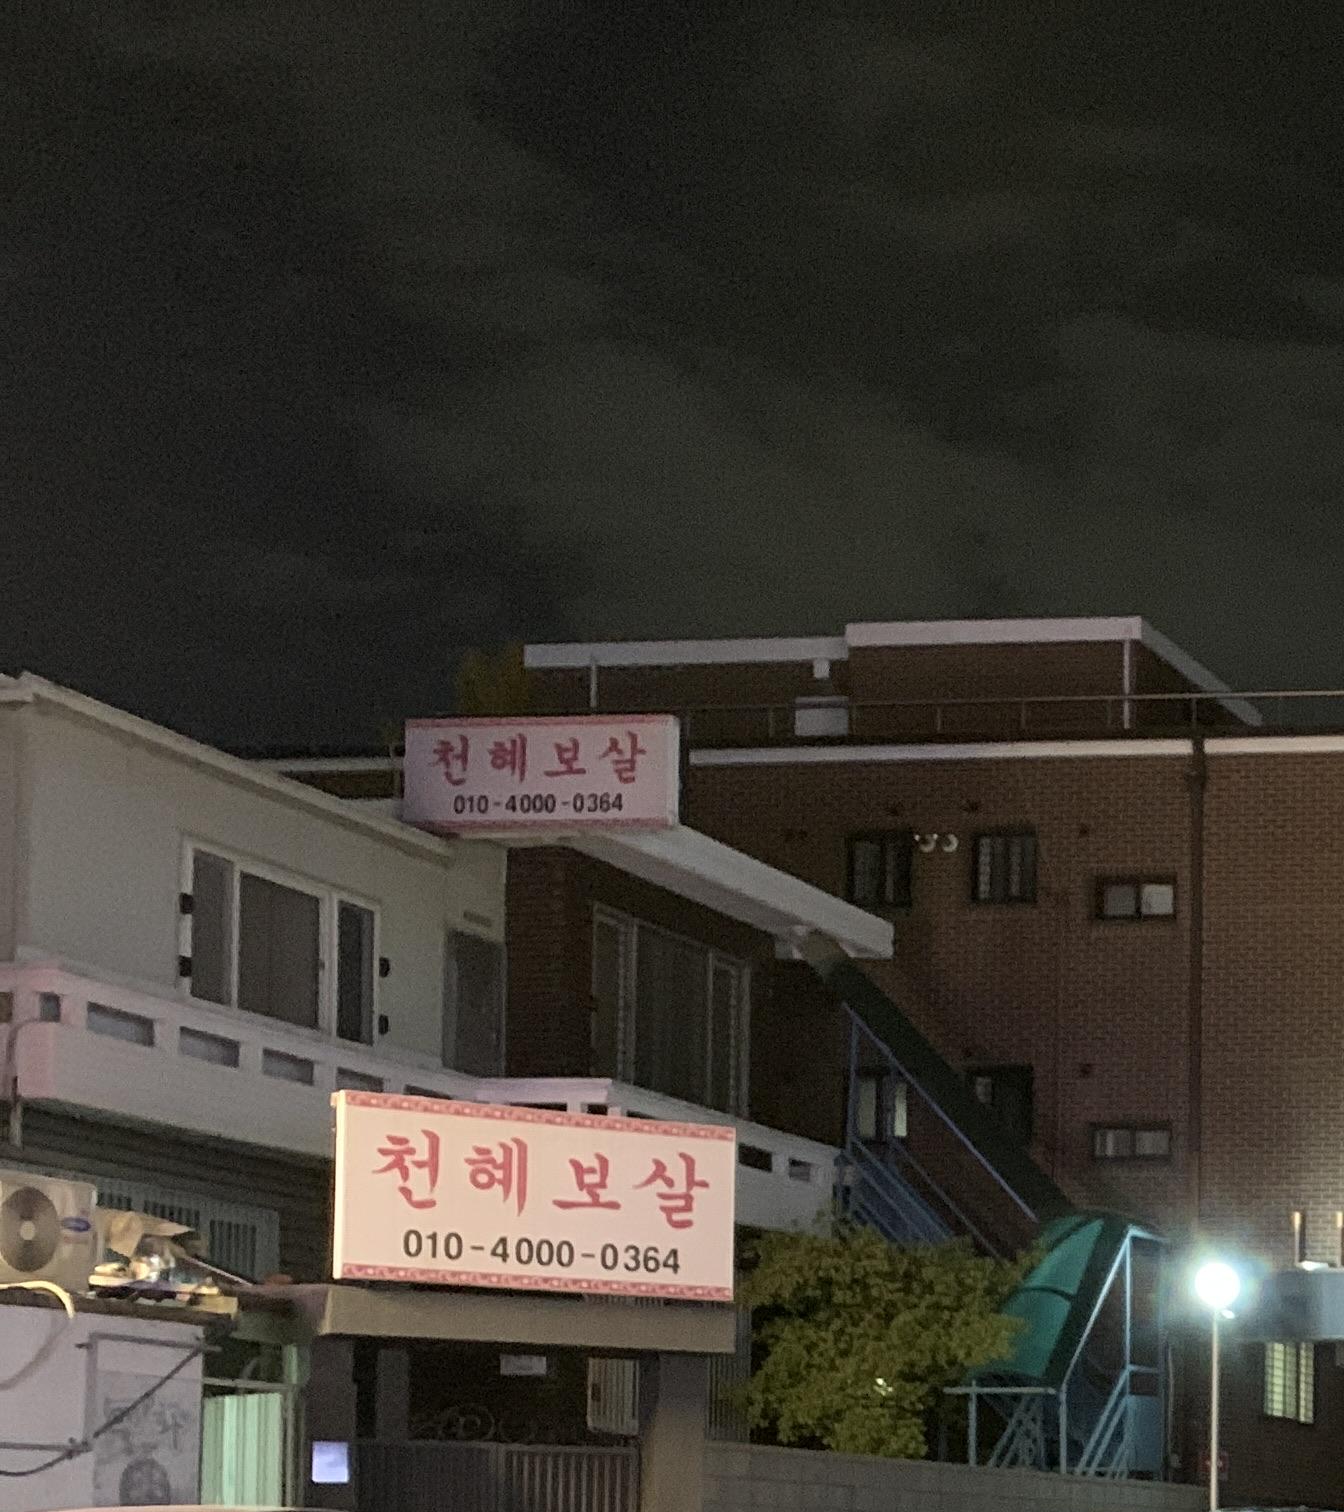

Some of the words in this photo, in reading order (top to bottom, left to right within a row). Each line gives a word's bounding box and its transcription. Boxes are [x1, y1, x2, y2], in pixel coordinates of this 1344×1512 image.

[433, 731, 647, 786] 천혜보살
[453, 792, 624, 815] 010-4000-0364
[372, 1129, 710, 1229] 천혜보살
[403, 1229, 681, 1275] 010-4000-0364
